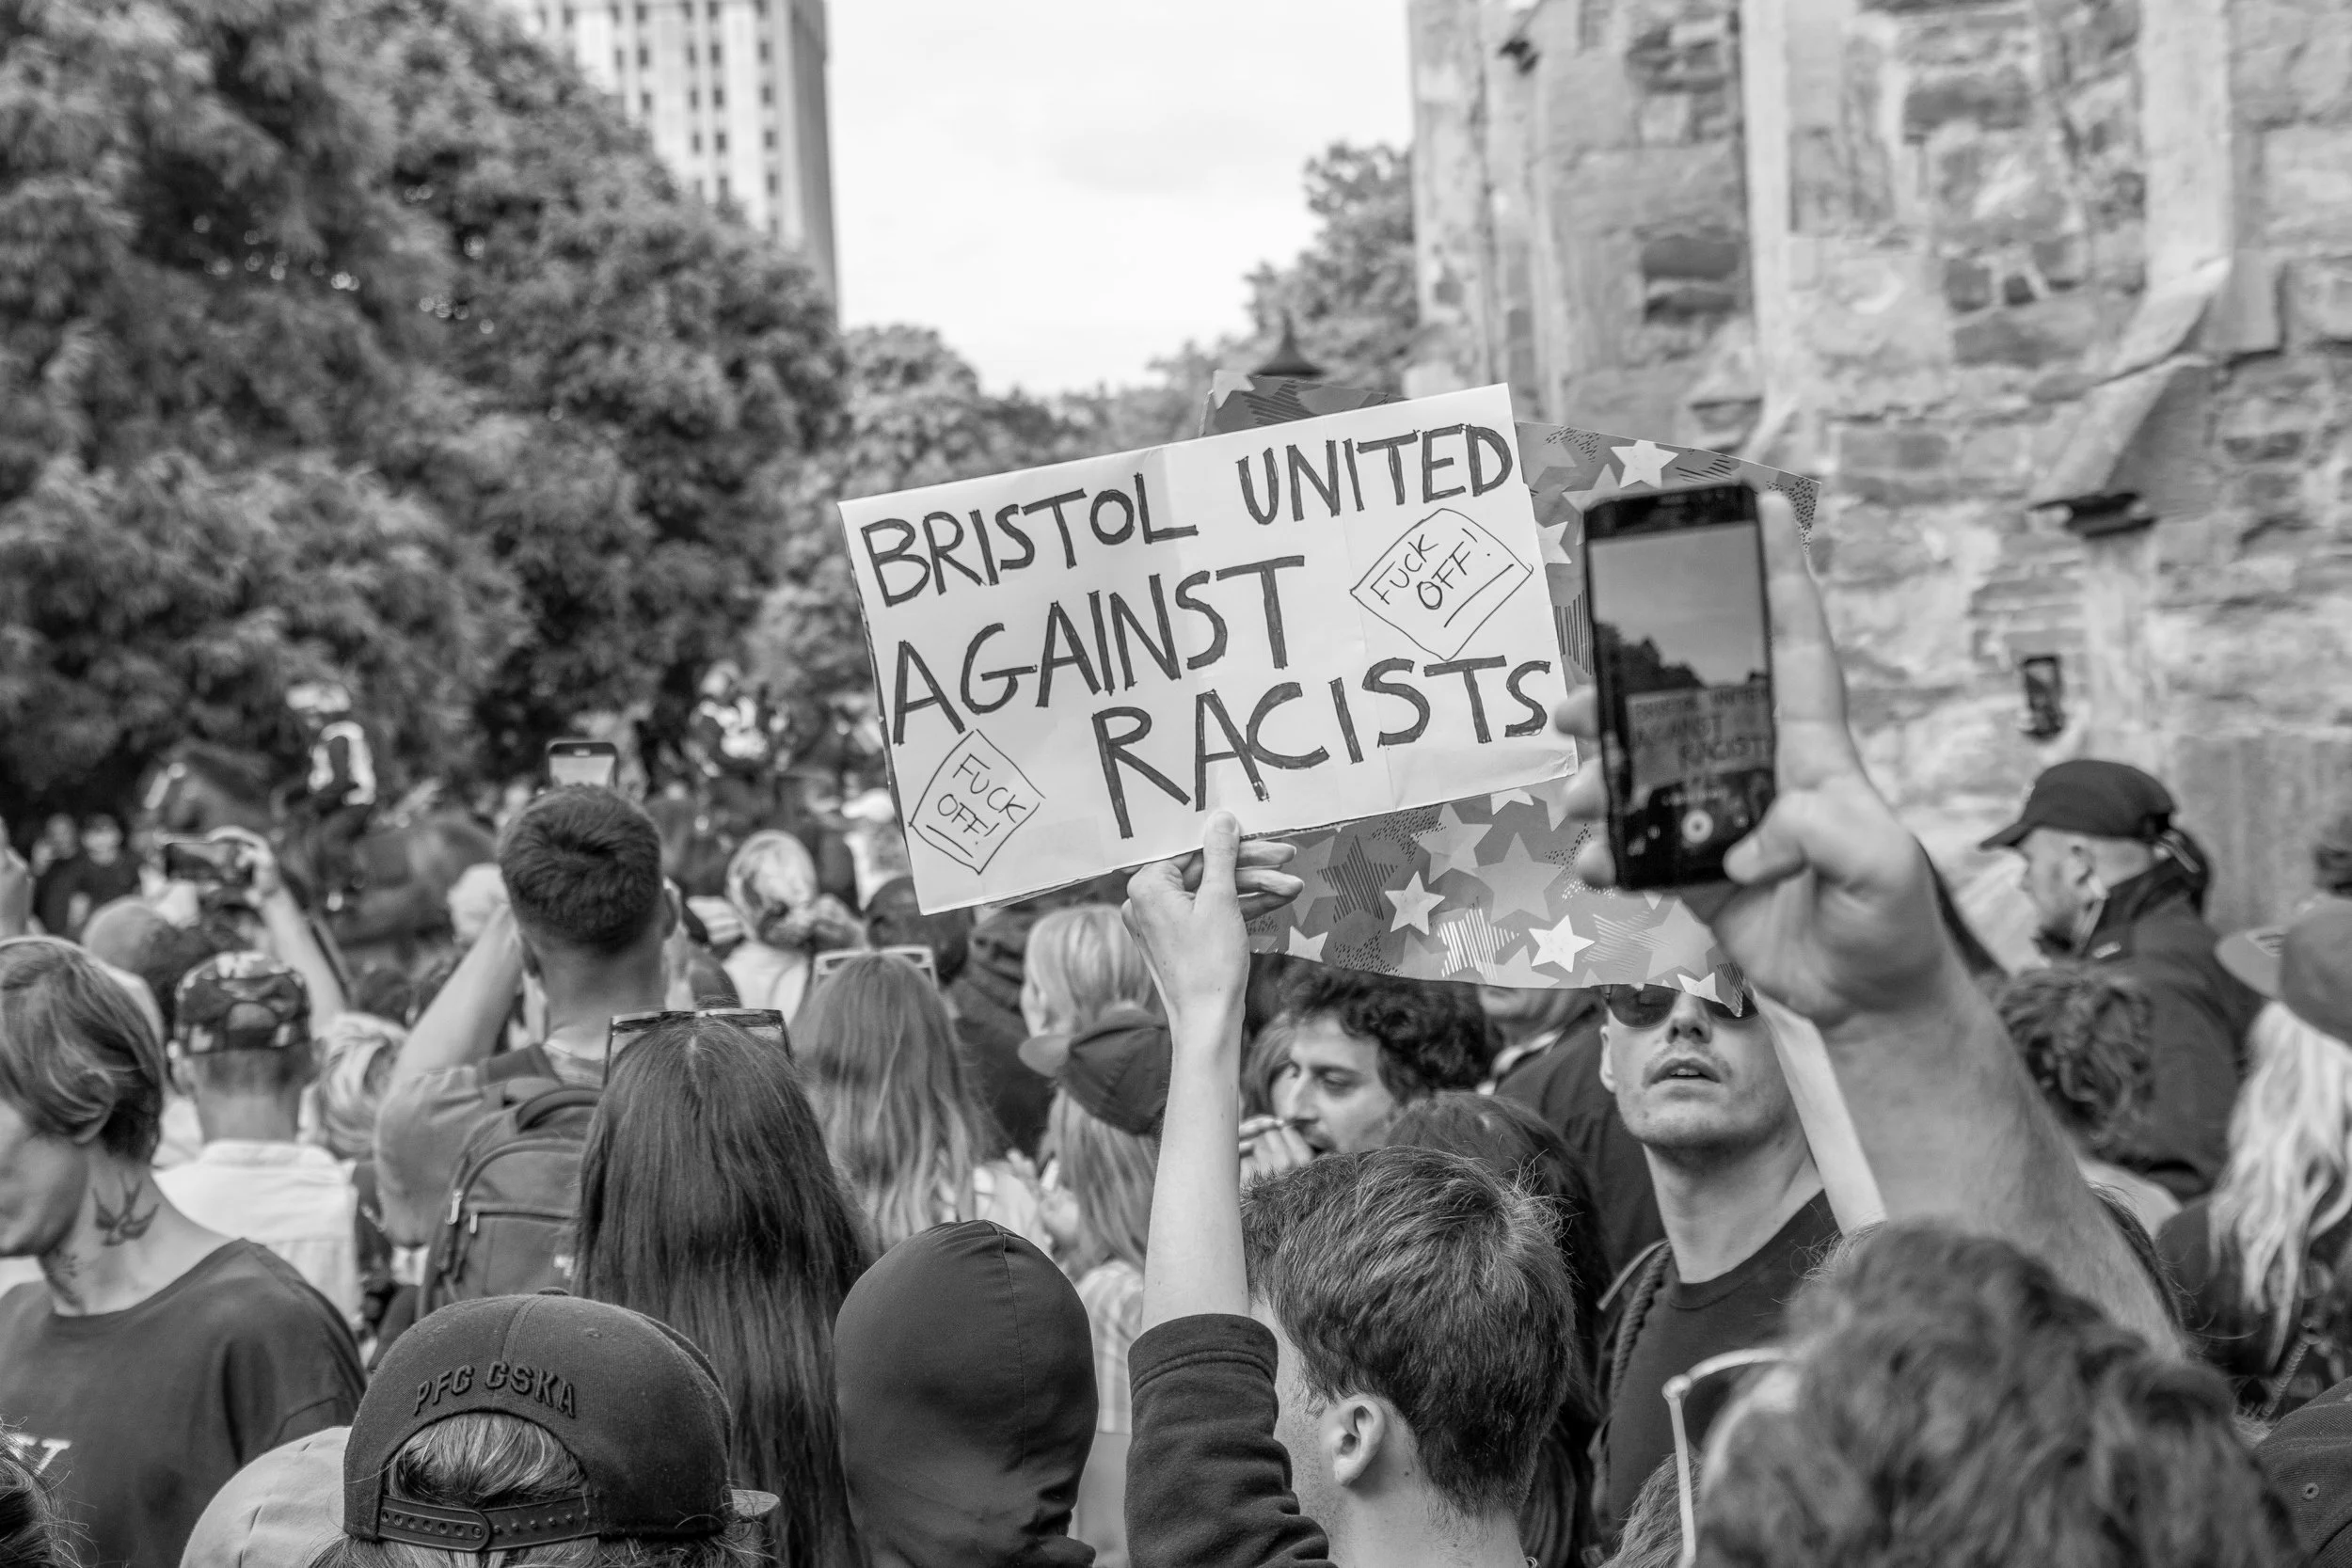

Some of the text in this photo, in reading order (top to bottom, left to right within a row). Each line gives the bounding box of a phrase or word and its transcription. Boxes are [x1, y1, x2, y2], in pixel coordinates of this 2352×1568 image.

[861, 422, 1514, 608] BRISTOL UNITED
[1370, 533, 1439, 605] FUCK
[1416, 527, 1490, 610] OFF!
[893, 555, 1306, 745] AGAINST
[952, 753, 1027, 824] FUCK
[1091, 656, 1551, 839] RACISTS
[937, 793, 1001, 846] OFF!
